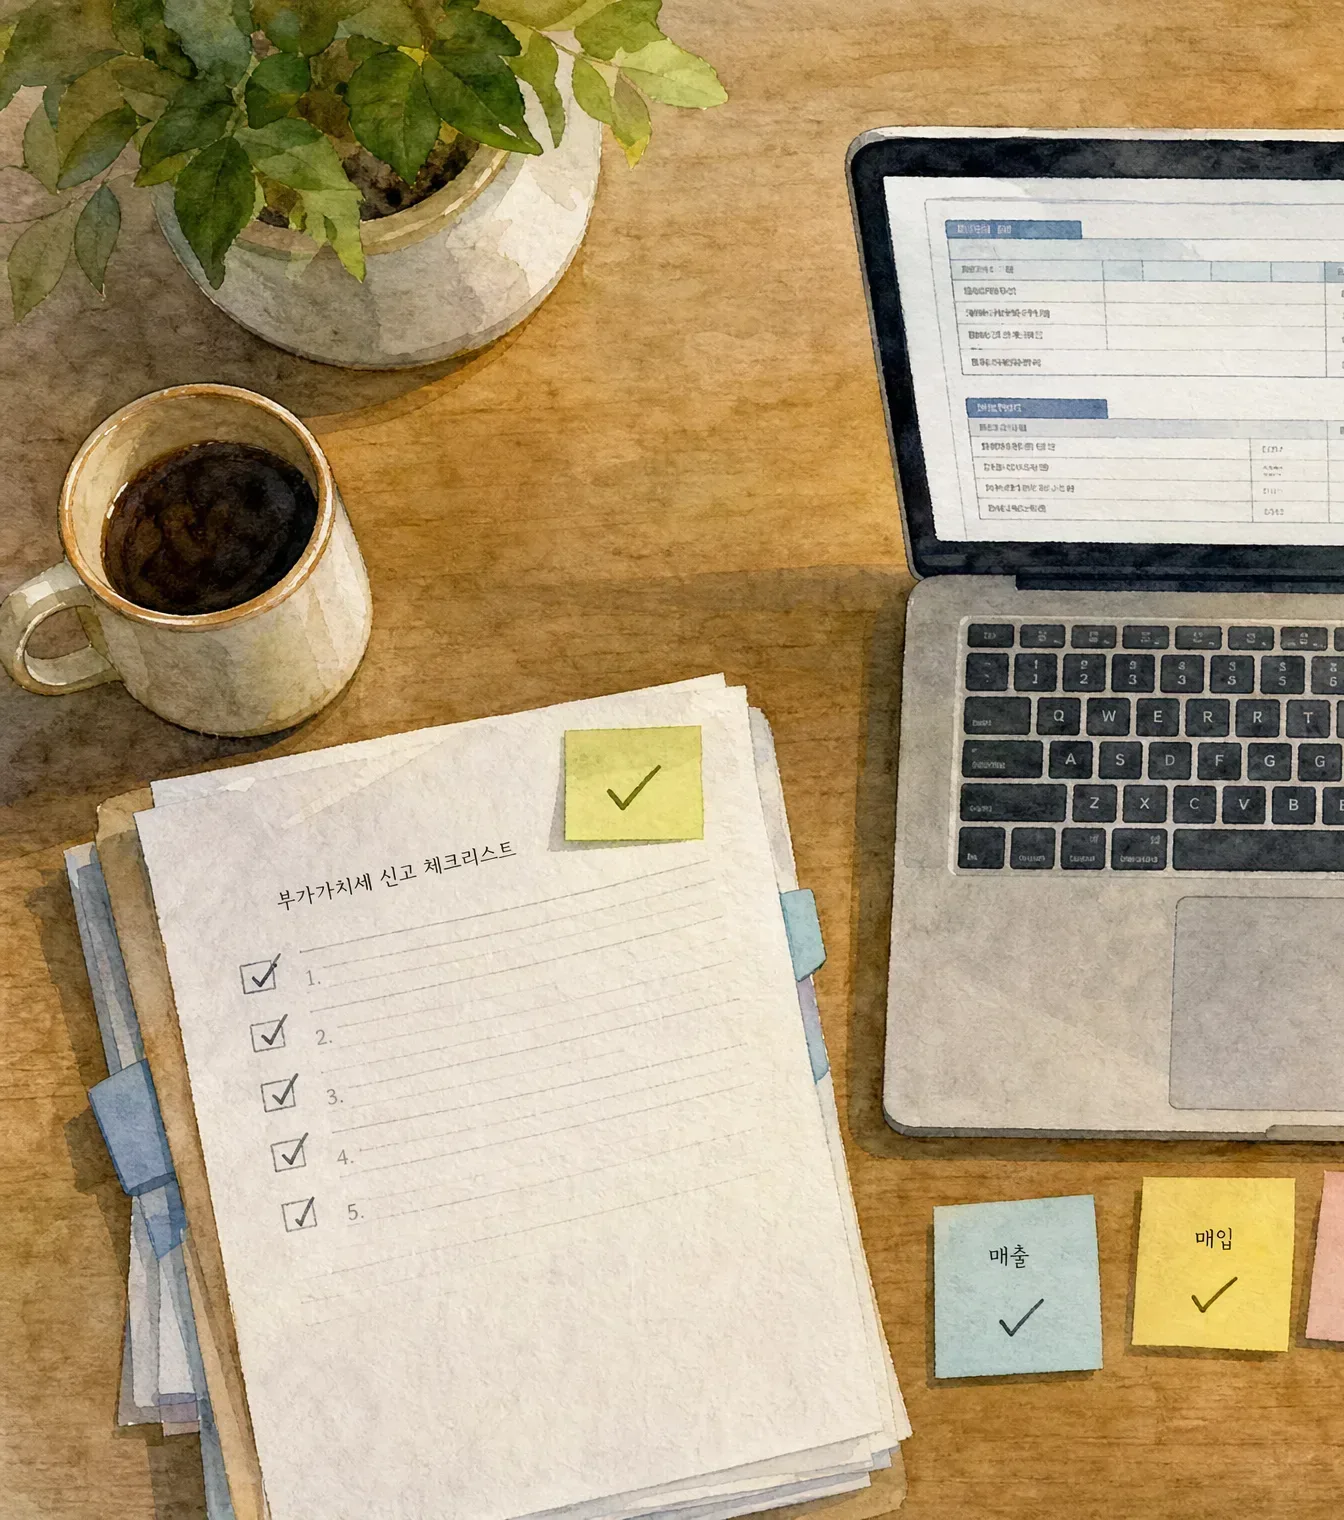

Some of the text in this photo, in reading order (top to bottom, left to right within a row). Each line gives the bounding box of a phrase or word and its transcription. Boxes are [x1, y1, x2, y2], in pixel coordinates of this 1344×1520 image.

[1032, 673, 1038, 685] 1
[1079, 673, 1089, 685] 2
[1053, 709, 1065, 723] Q
[1102, 709, 1117, 723] W
[1153, 710, 1163, 723] E
[1203, 710, 1213, 723] R
[1253, 710, 1263, 724] R
[1302, 711, 1314, 724] T
[1064, 752, 1077, 765] A
[1115, 753, 1125, 766] S
[1165, 754, 1176, 766] D
[1215, 754, 1225, 767] F
[1263, 754, 1276, 768] G
[1314, 755, 1326, 768] G
[1089, 796, 1100, 809] Z
[1139, 797, 1150, 810] X
[1189, 797, 1200, 810] C
[1238, 798, 1251, 811] V
[1288, 798, 1299, 811] B
[277, 841, 517, 911] 부가가치세 신고 체크리스트
[1195, 1227, 1232, 1251] 매입
[989, 1244, 1030, 1269] 매출
